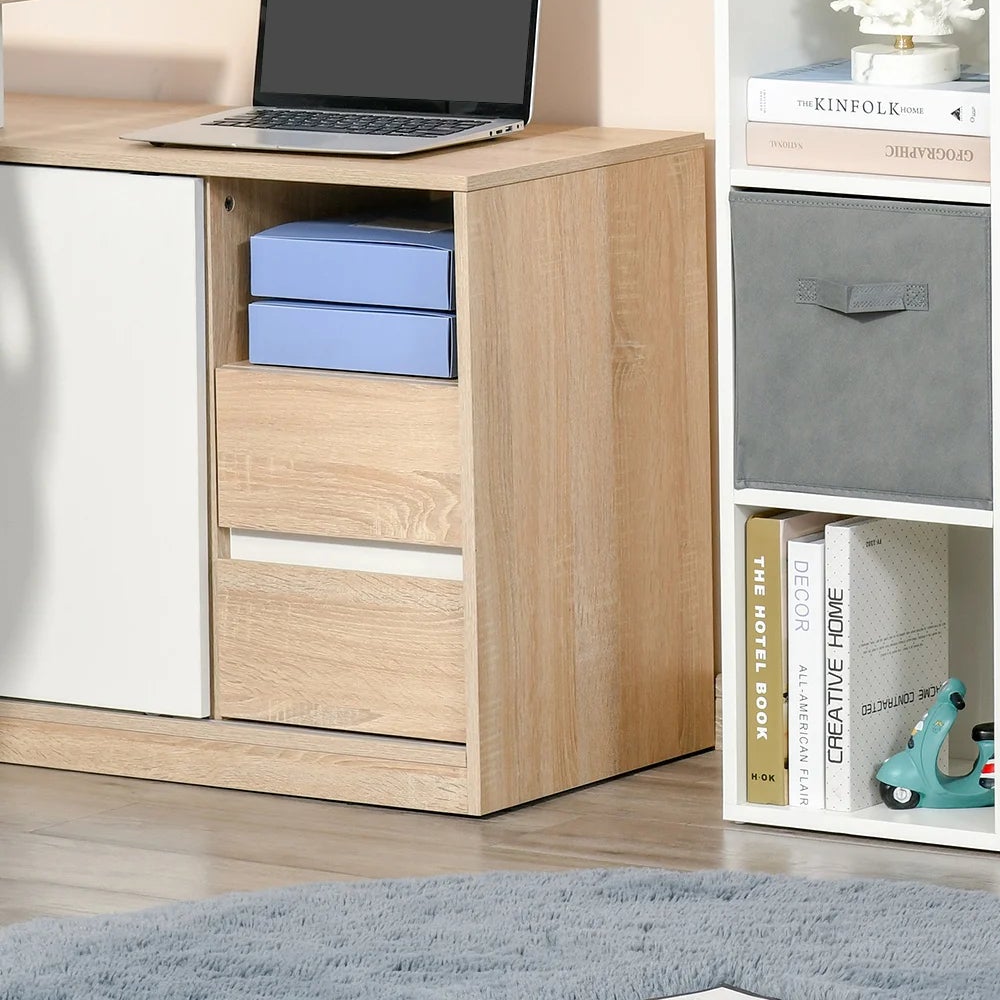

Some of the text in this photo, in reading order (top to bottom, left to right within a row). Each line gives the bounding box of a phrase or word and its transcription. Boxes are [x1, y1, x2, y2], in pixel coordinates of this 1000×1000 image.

[797, 97, 924, 116] THE KINFOLK HOME
[769, 139, 803, 150] NATIONAL
[793, 560, 810, 632] DECOR
[753, 556, 768, 740] THE HOTEL BOOK
[828, 588, 844, 764] CREATIVE HOME
[798, 664, 809, 806] ALL-AMERICAN FLAIR
[860, 694, 916, 716] CONTRACTED
